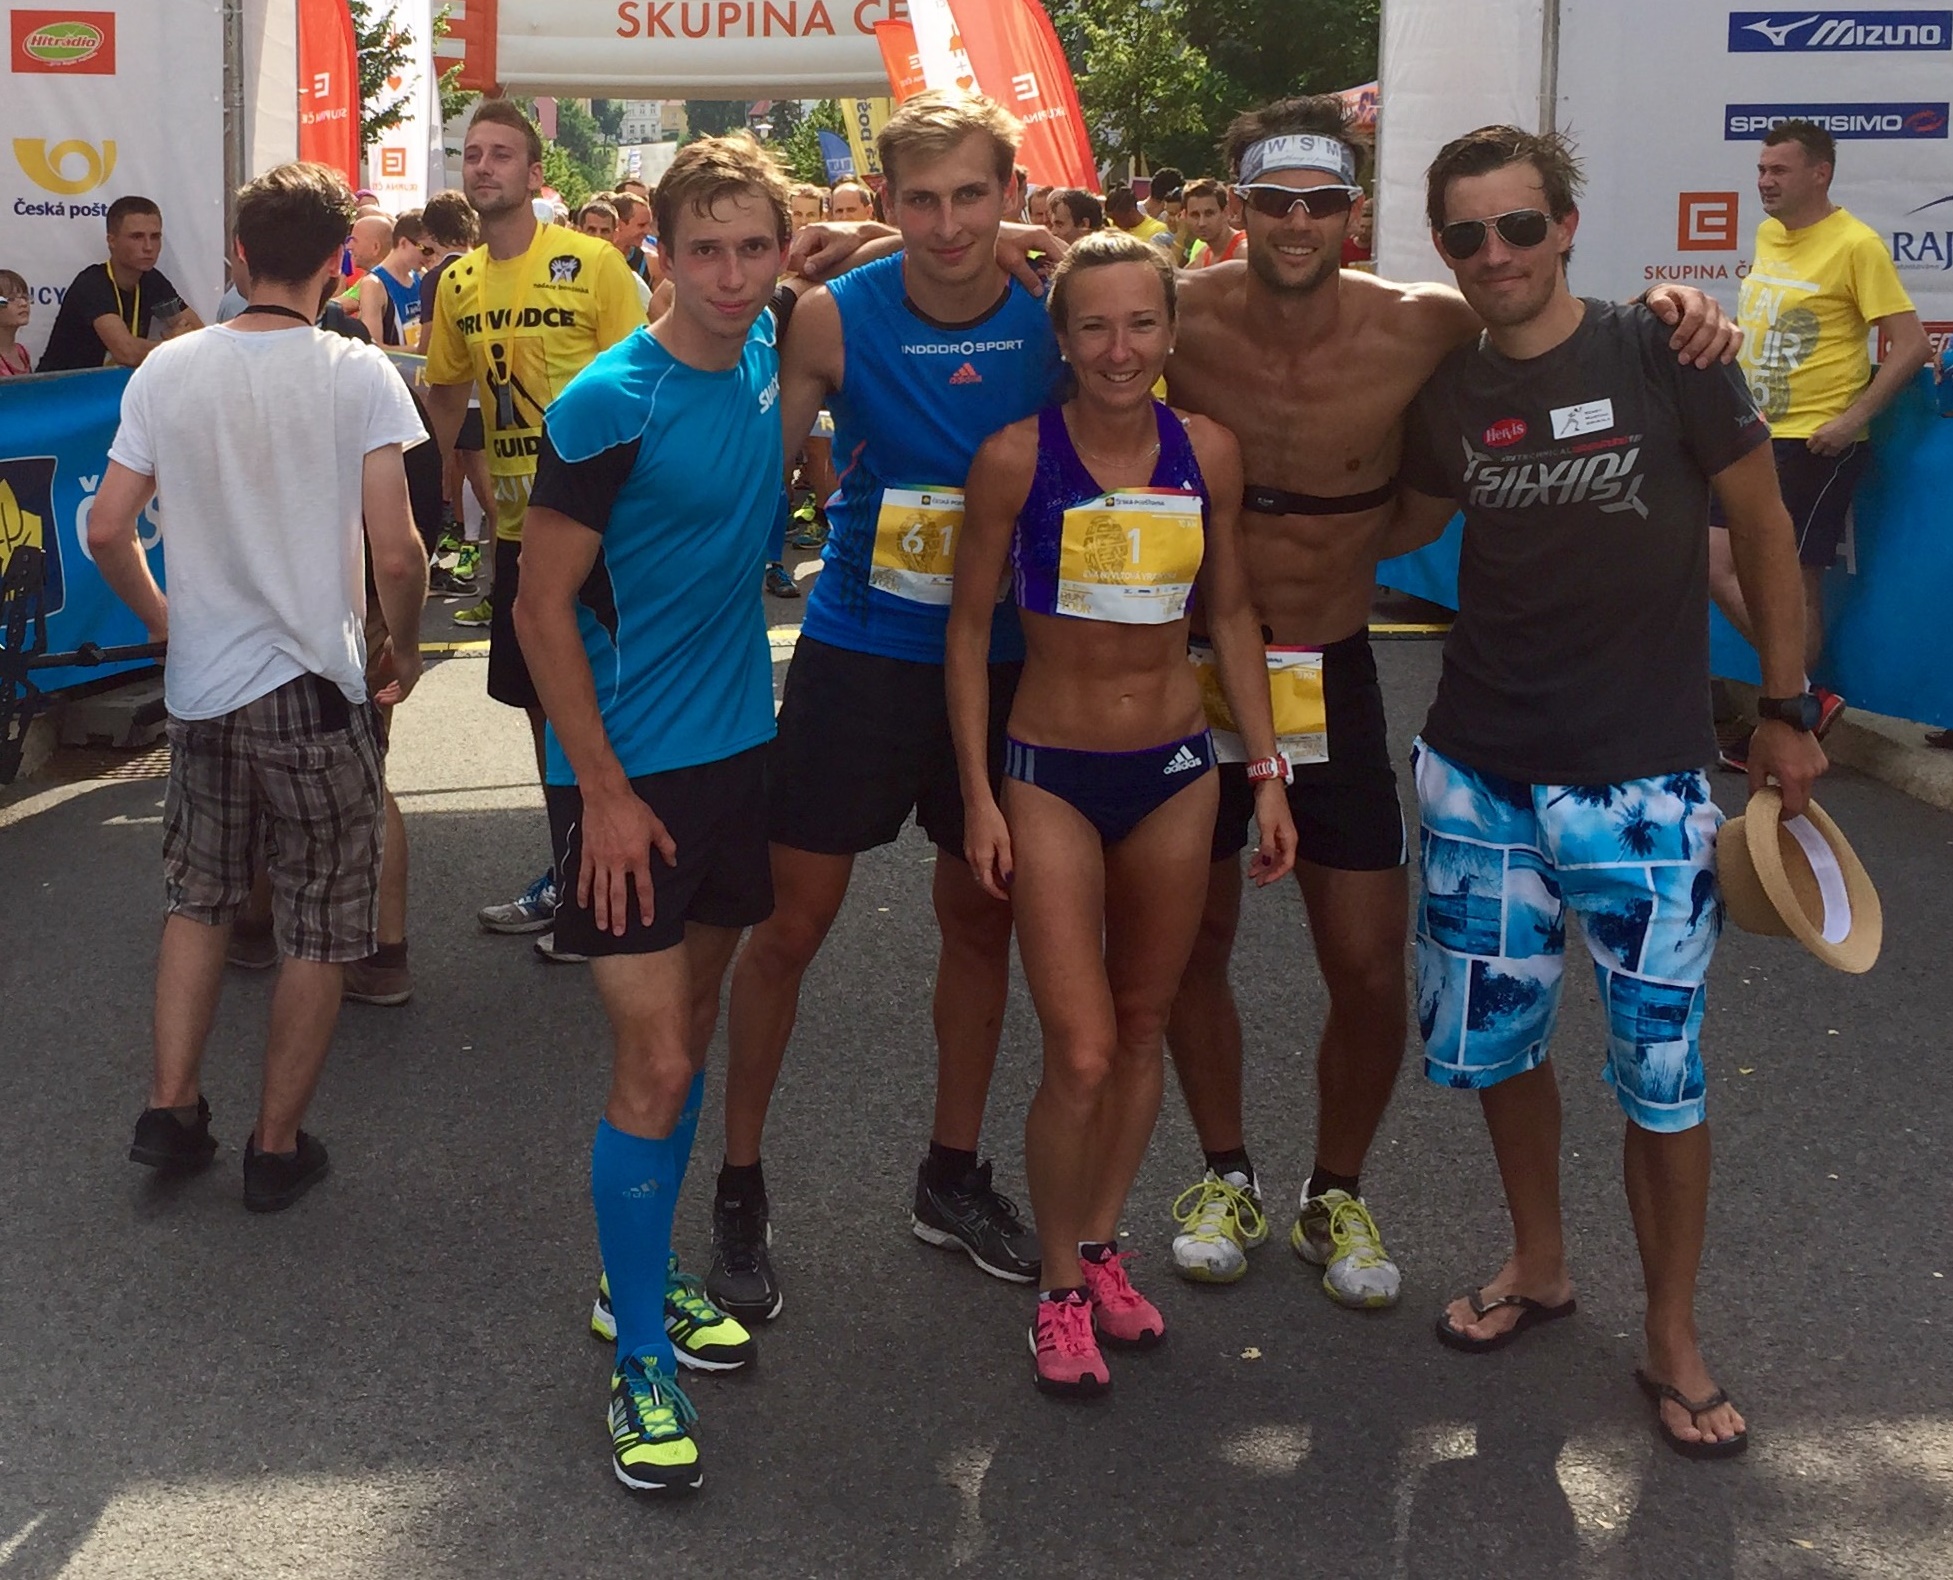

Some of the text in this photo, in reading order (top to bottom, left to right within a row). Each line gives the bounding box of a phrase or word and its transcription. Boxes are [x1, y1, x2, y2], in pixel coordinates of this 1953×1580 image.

[616, 0, 836, 38] SKUPINA
[30, 34, 97, 47] Hitradio
[14, 197, 108, 219] Česká pošt
[1644, 264, 1728, 280] SKUPINA
[1485, 421, 1526, 443] Hervis
[1127, 528, 1141, 564] 1
[1163, 757, 1202, 775] adidas
